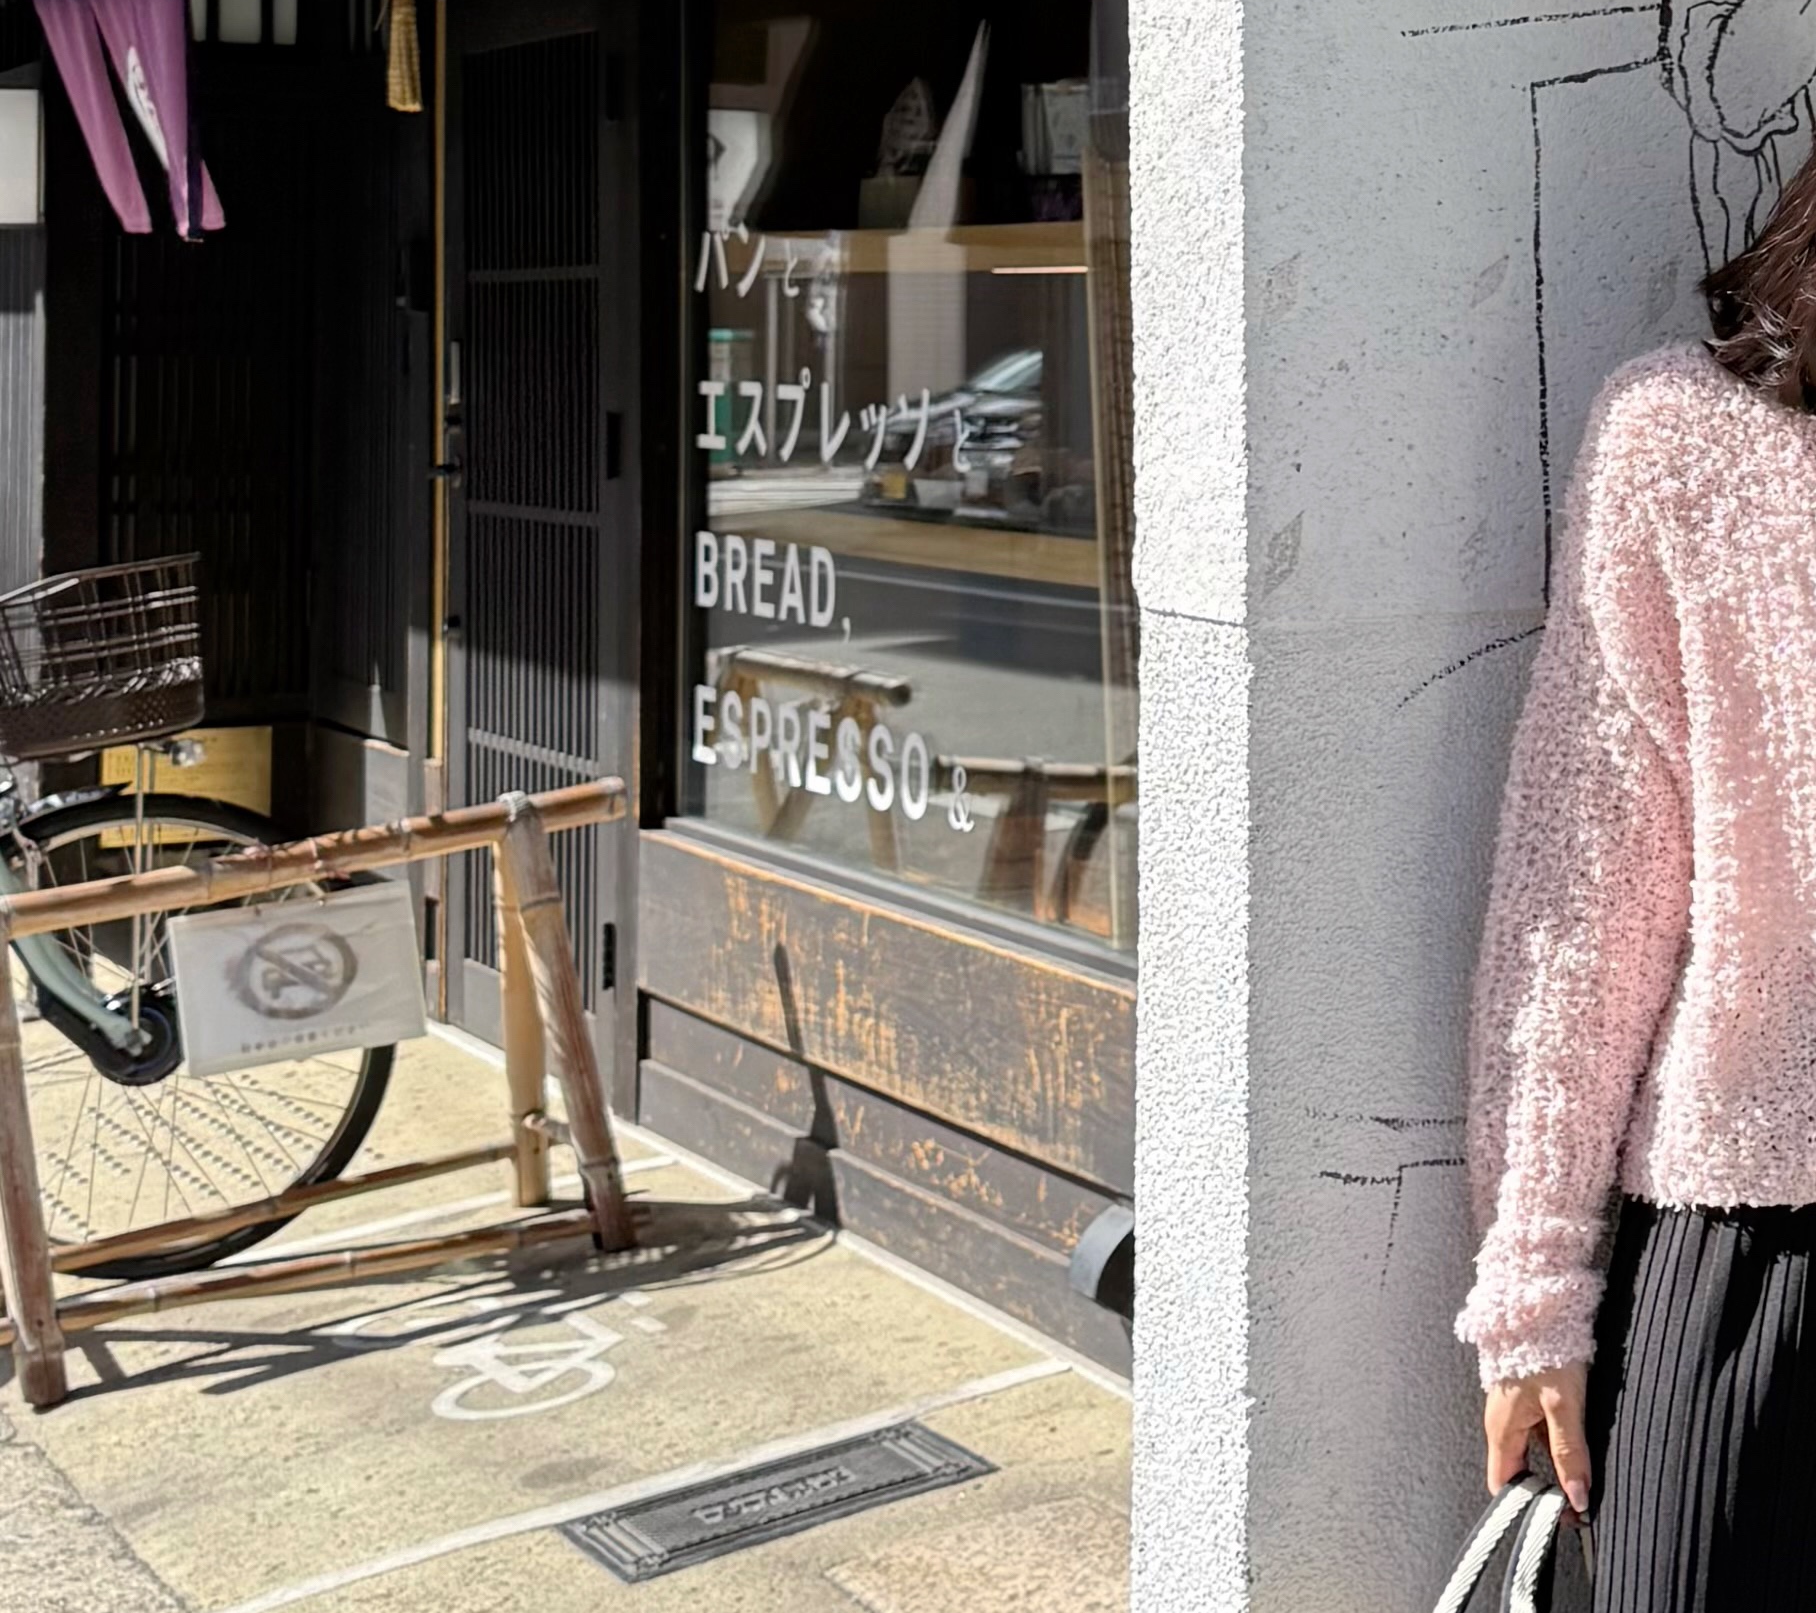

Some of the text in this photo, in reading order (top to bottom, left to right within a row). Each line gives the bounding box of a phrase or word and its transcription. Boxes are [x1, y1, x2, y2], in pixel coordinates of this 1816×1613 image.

[695, 530, 850, 644] BREAD,
[692, 684, 975, 833] ESPRESSO &
